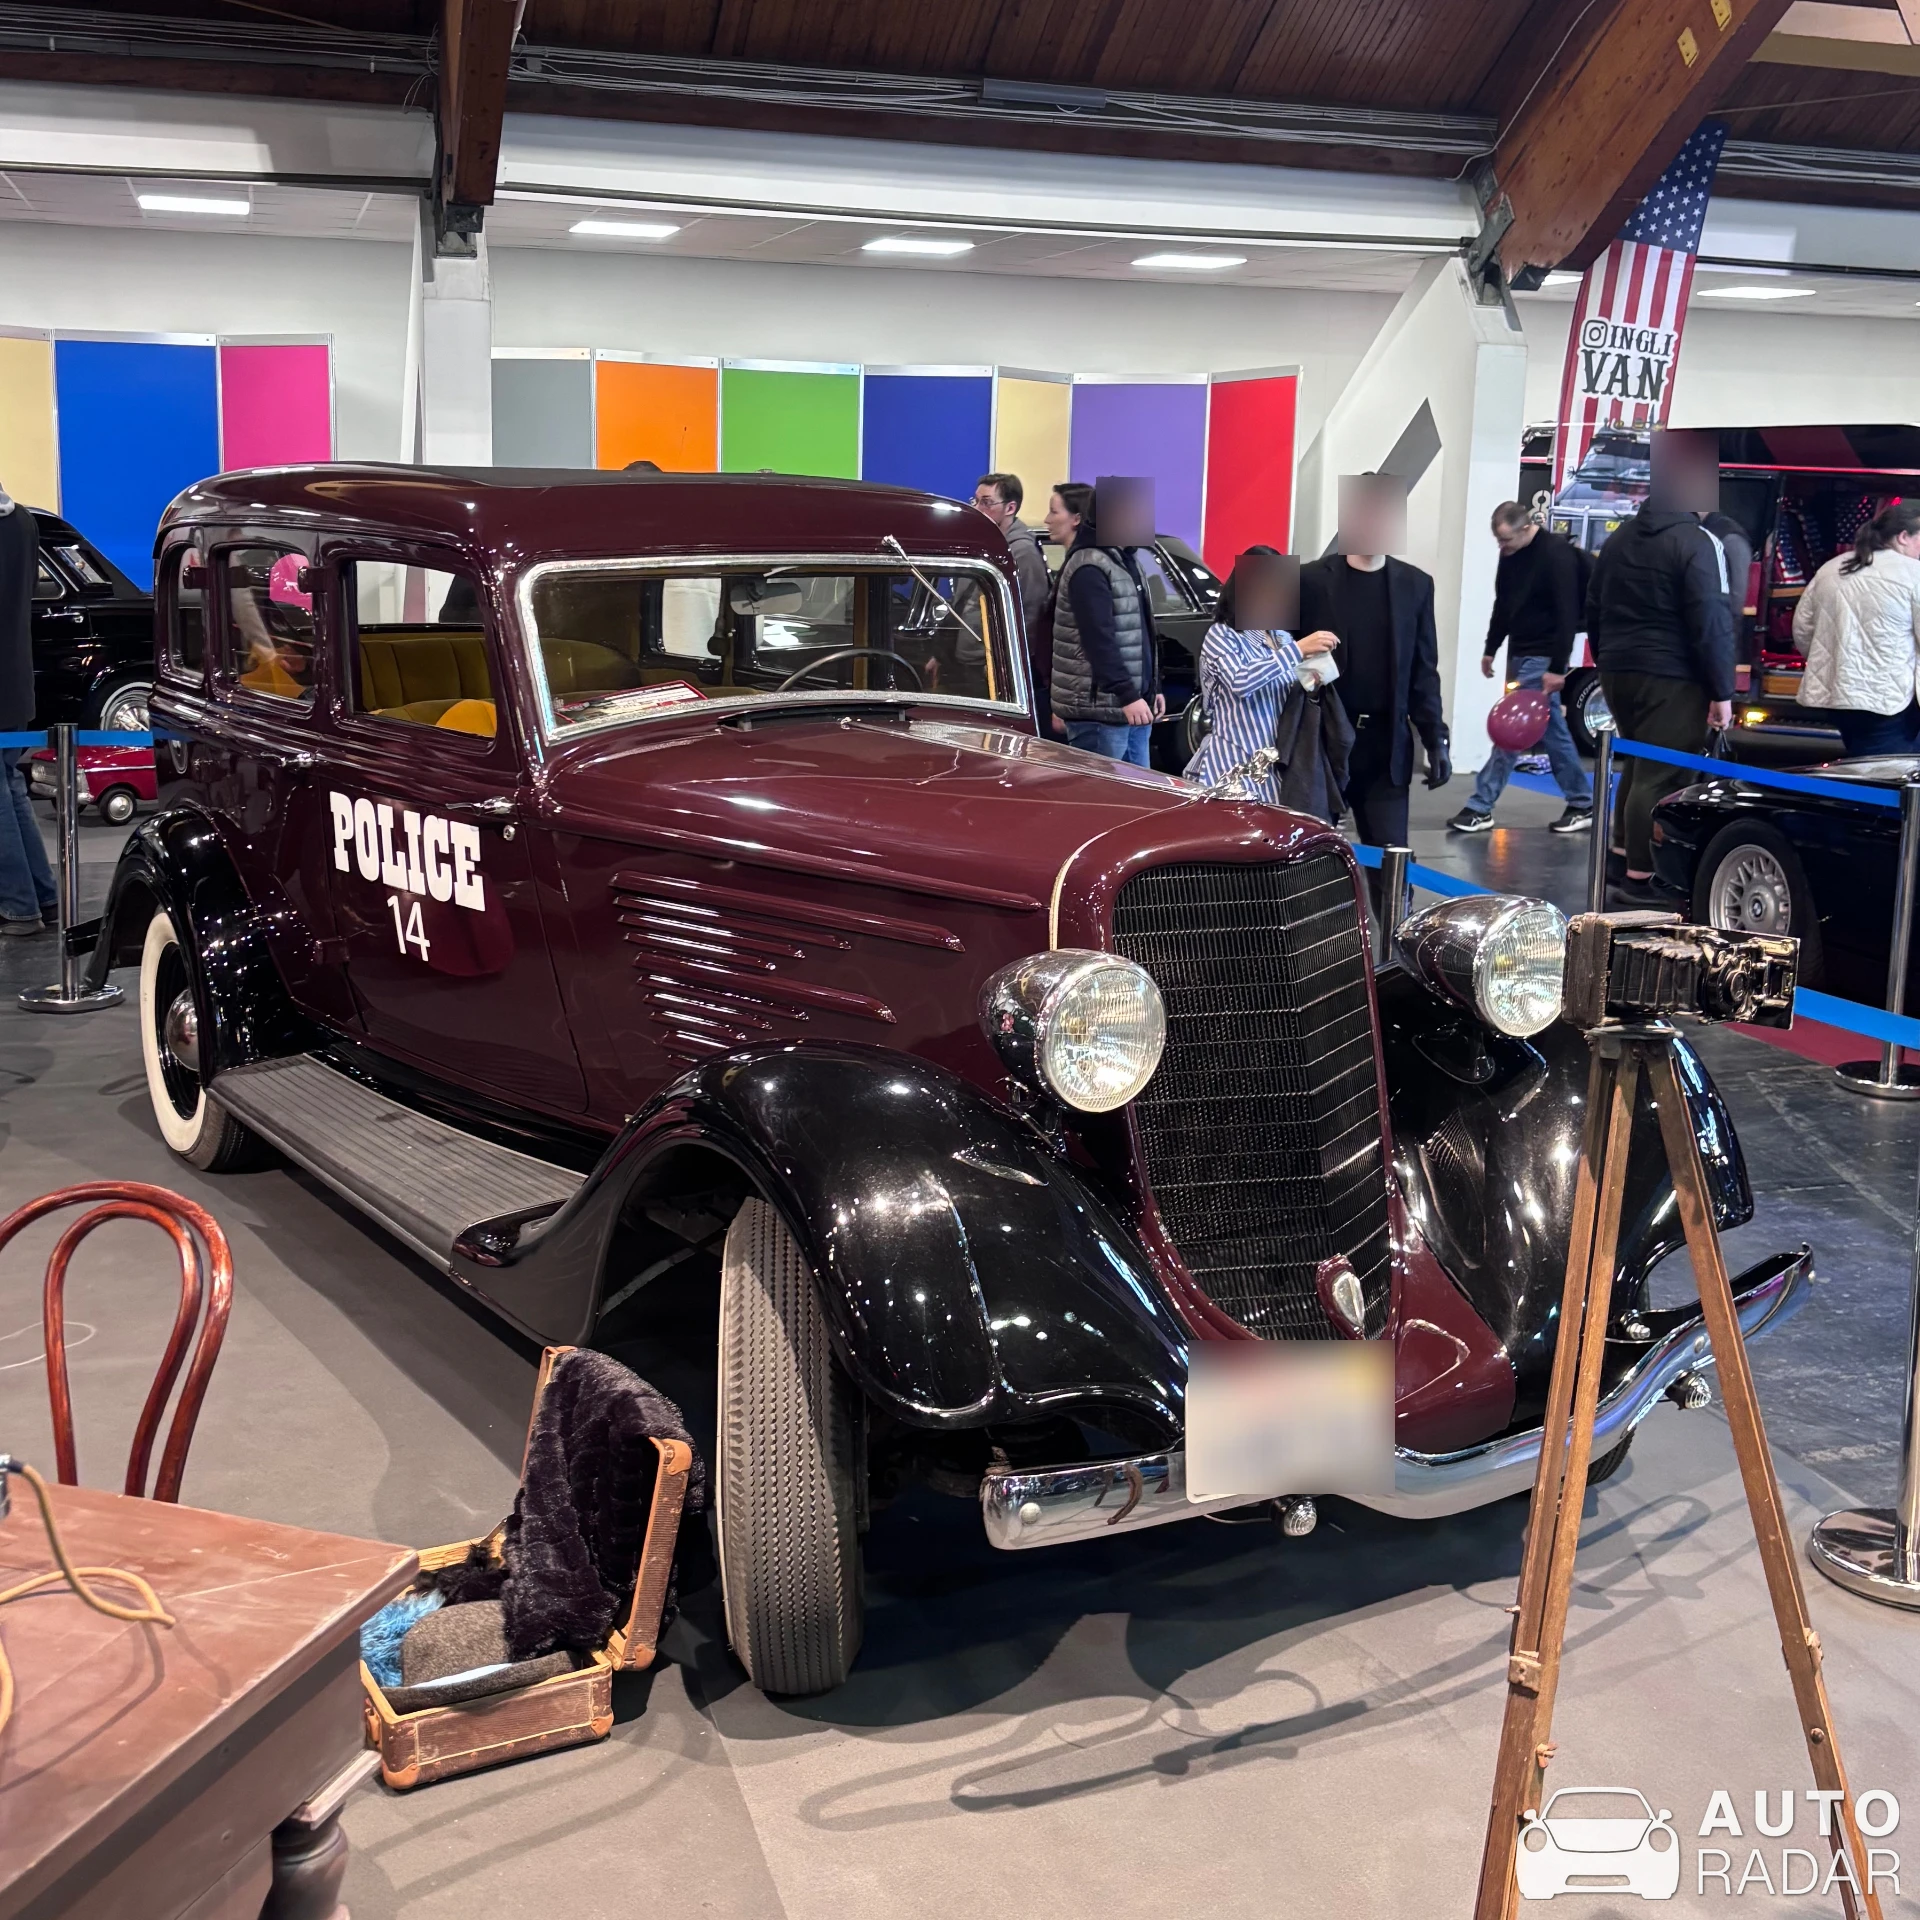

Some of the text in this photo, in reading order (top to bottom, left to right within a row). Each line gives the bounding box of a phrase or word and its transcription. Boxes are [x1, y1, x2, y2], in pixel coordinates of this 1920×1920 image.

[1608, 325, 1675, 356] INGLI
[1580, 349, 1669, 401] VAN
[1576, 679, 1599, 709] COOPE
[329, 790, 486, 912] POLICE
[387, 895, 431, 962] 14
